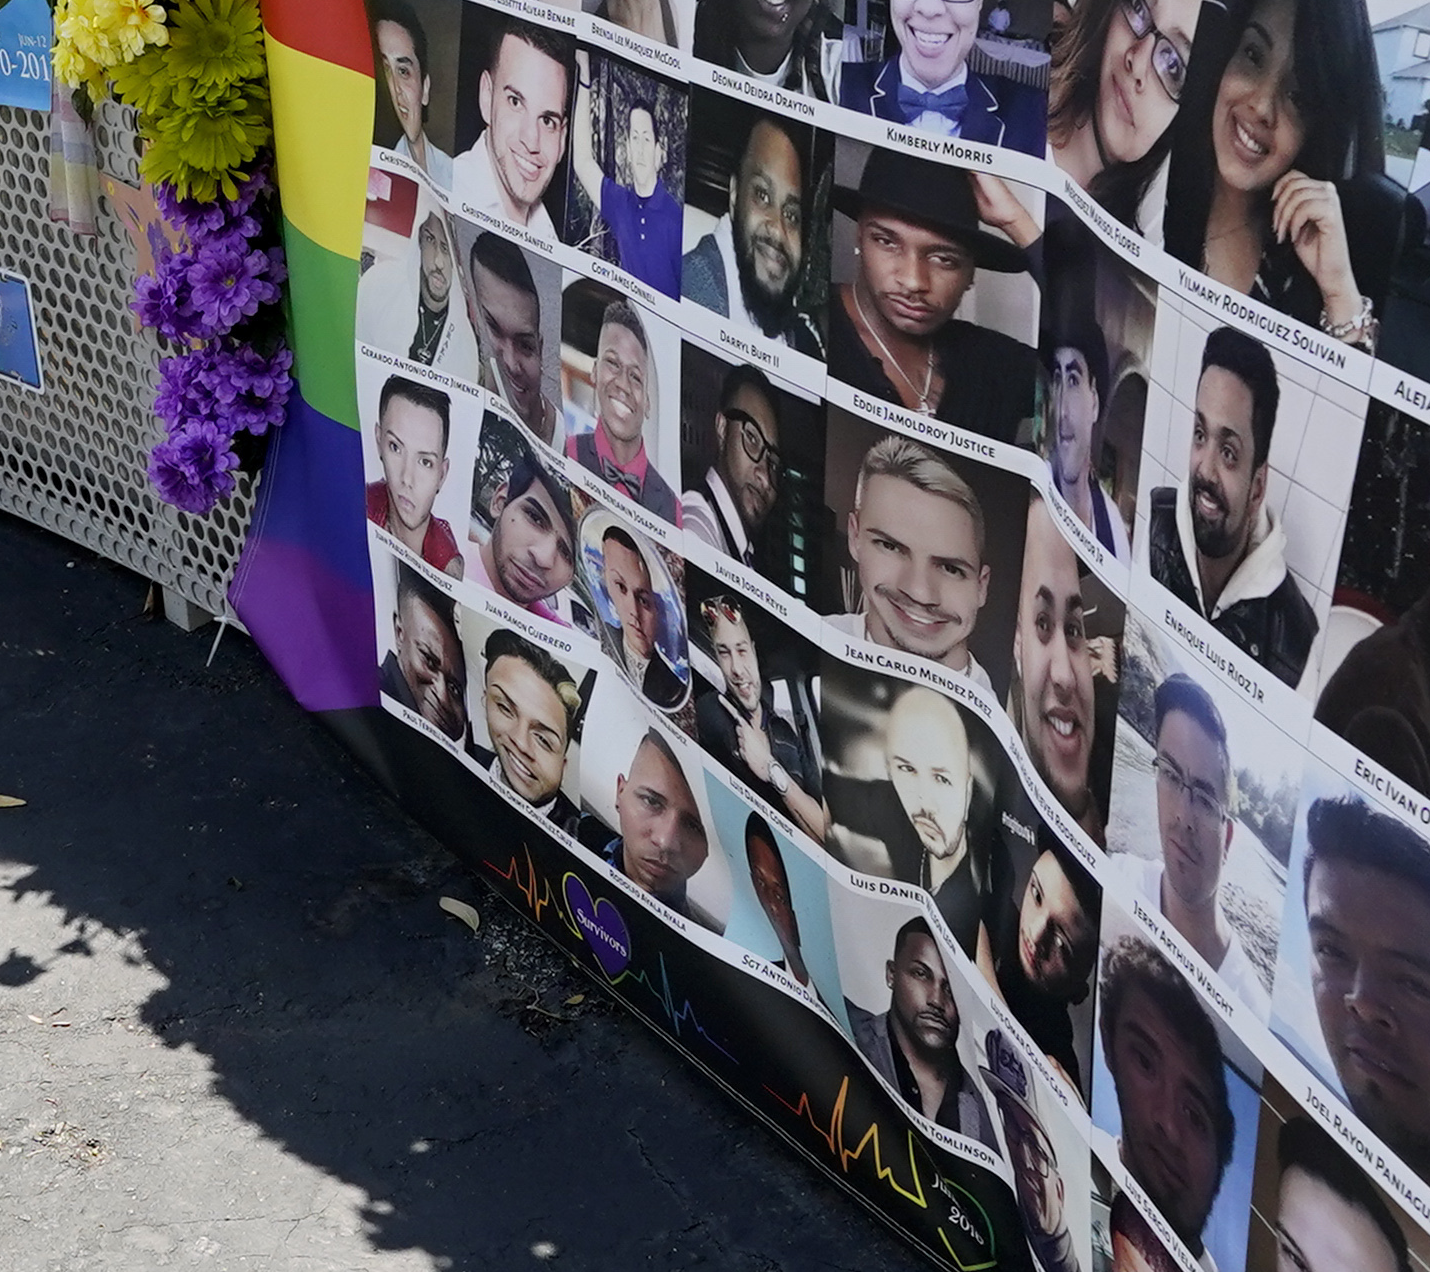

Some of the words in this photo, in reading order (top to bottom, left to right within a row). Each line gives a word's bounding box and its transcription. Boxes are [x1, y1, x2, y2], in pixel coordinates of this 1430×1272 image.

[547, 9, 575, 27] BENABE
[591, 23, 613, 40] BRENDA
[614, 30, 624, 44] LEE
[624, 35, 653, 58] MARQUEZ
[712, 70, 742, 92] DEONKA
[744, 81, 774, 102] DEIDRA
[775, 93, 815, 116] DRAYTON
[886, 127, 940, 153] KIMBERLY
[942, 143, 993, 165] MORRIS
[462, 202, 501, 228] CHRISTOPHER
[500, 220, 524, 238] JOSEPH
[524, 233, 553, 254] SANFELIZ
[1114, 228, 1140, 258] FLORES
[591, 262, 611, 279] CORY
[611, 270, 630, 290] JAMES
[630, 280, 656, 305] CONNELL
[1178, 268, 1220, 306] YILMARY
[1222, 290, 1290, 341] RODRIGUEZ
[1293, 331, 1346, 369] SOLIVAN
[361, 345, 393, 366] GERARDO
[393, 358, 426, 377] ANTONIO
[427, 369, 449, 385] ORTIZ
[449, 377, 479, 397] JIMENEZ
[720, 330, 749, 354] DARRYL
[751, 345, 772, 364] BURT
[853, 394, 882, 417] EDDIE
[883, 408, 948, 442] JAMOLDROY
[950, 431, 996, 458] JUSTICE
[631, 509, 666, 539] JOSAPHAT
[715, 561, 741, 587] JAVIER
[741, 577, 764, 601] JORGE
[765, 592, 787, 617] REYES
[485, 601, 502, 618] JUAN
[504, 609, 527, 632] RAMON
[528, 625, 572, 652] GUERRERO
[845, 644, 874, 665] JEAN
[876, 655, 916, 676] CARLO
[919, 667, 966, 699] MENDEZ
[967, 690, 992, 718] PEREZ
[1164, 609, 1205, 654] ENRIQUE
[1206, 643, 1226, 671] LUIS
[1227, 658, 1251, 691] RIOZ
[1250, 678, 1264, 703] JR
[1354, 758, 1382, 792] ERIC
[1385, 780, 1417, 816] IVAN
[641, 890, 662, 916] AYALA
[664, 907, 686, 931] AYALA
[850, 874, 875, 892] LUIS
[879, 882, 924, 905] DANIEL
[576, 907, 628, 958] Survivors
[742, 954, 760, 971] SGT
[761, 965, 803, 996] ANTONIO
[1133, 900, 1158, 935] JERRY
[1159, 931, 1195, 974] ARTHUR
[1196, 967, 1234, 1017] WRIGHT
[929, 1125, 995, 1167] TOMLINSON
[1305, 1087, 1332, 1124] JOEL
[1333, 1114, 1373, 1164] RAYON
[1124, 1172, 1142, 1203] LUIS
[1141, 1196, 1171, 1243] SERGIO
